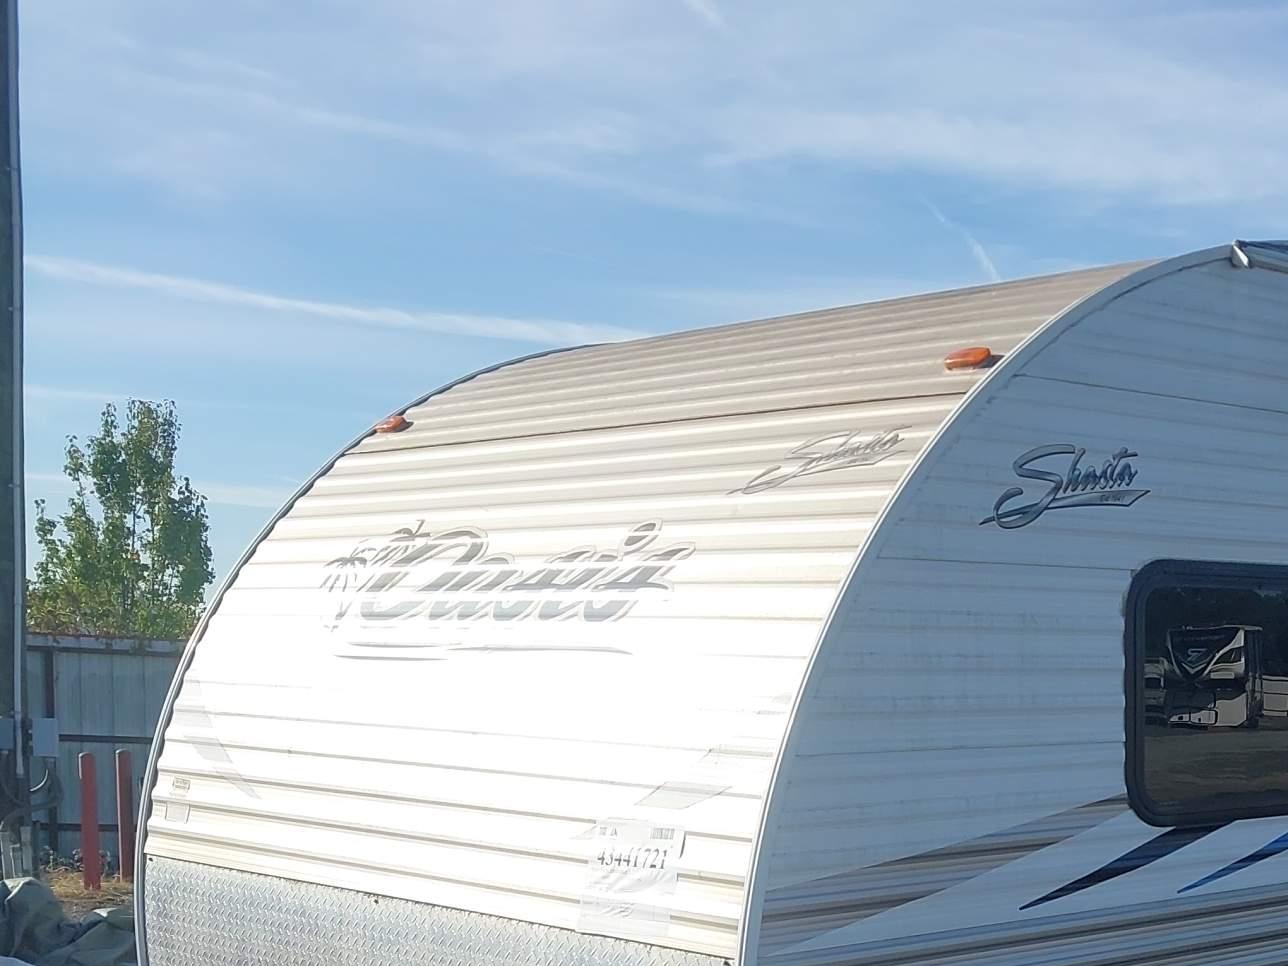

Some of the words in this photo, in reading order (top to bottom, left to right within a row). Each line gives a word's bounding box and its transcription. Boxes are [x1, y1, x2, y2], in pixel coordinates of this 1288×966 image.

[992, 443, 1139, 530] Shasta
[357, 518, 697, 626] Oasis
[596, 846, 668, 870] 43441721
